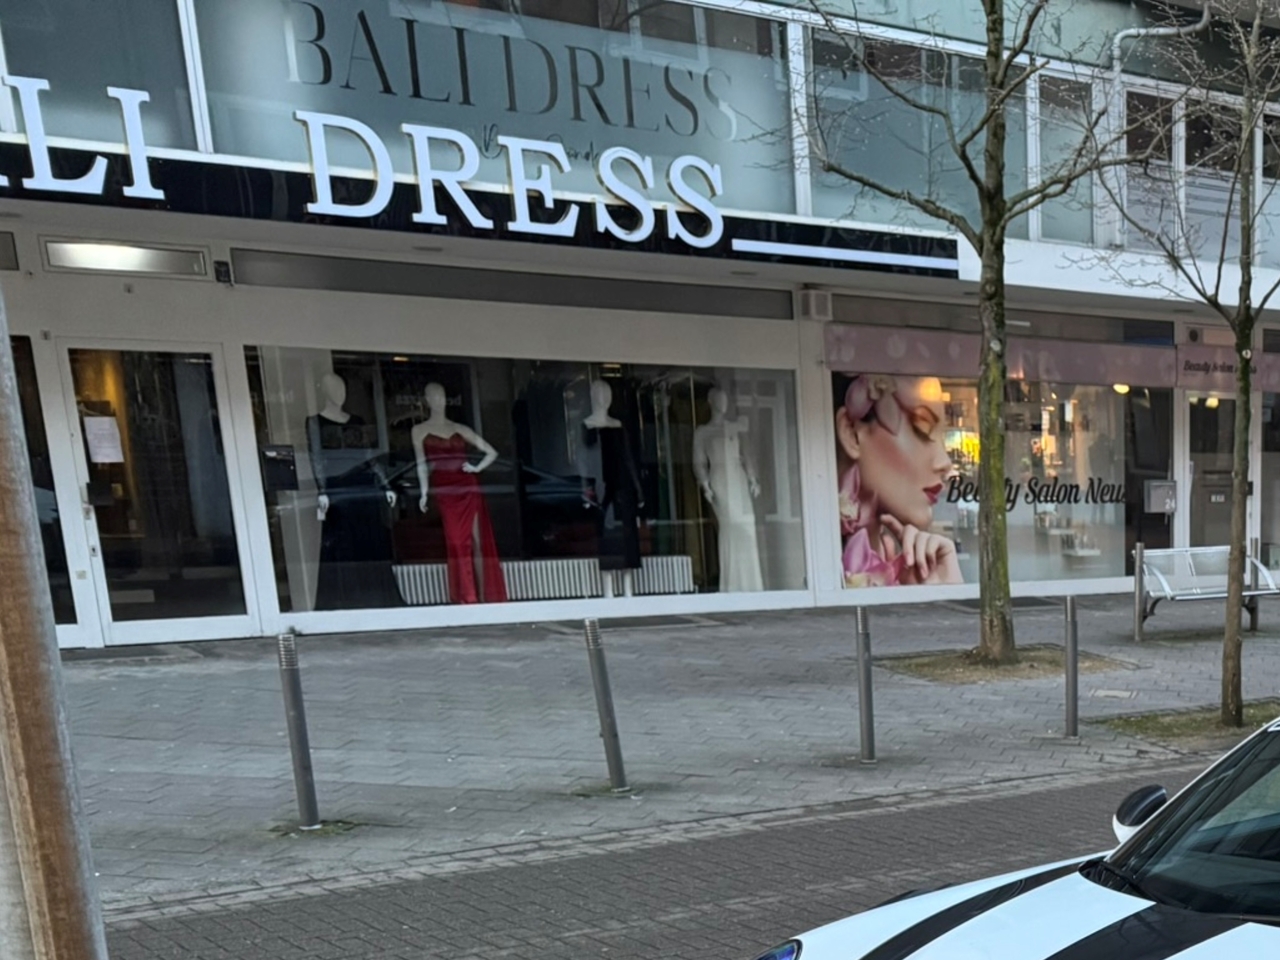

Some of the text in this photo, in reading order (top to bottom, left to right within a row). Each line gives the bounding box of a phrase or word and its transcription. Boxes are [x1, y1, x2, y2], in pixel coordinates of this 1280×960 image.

[292, 1, 739, 142] BALI DRESS
[0, 75, 724, 249] LI DRESS
[1024, 476, 1080, 505] Salon
[1164, 498, 1176, 510] 24
